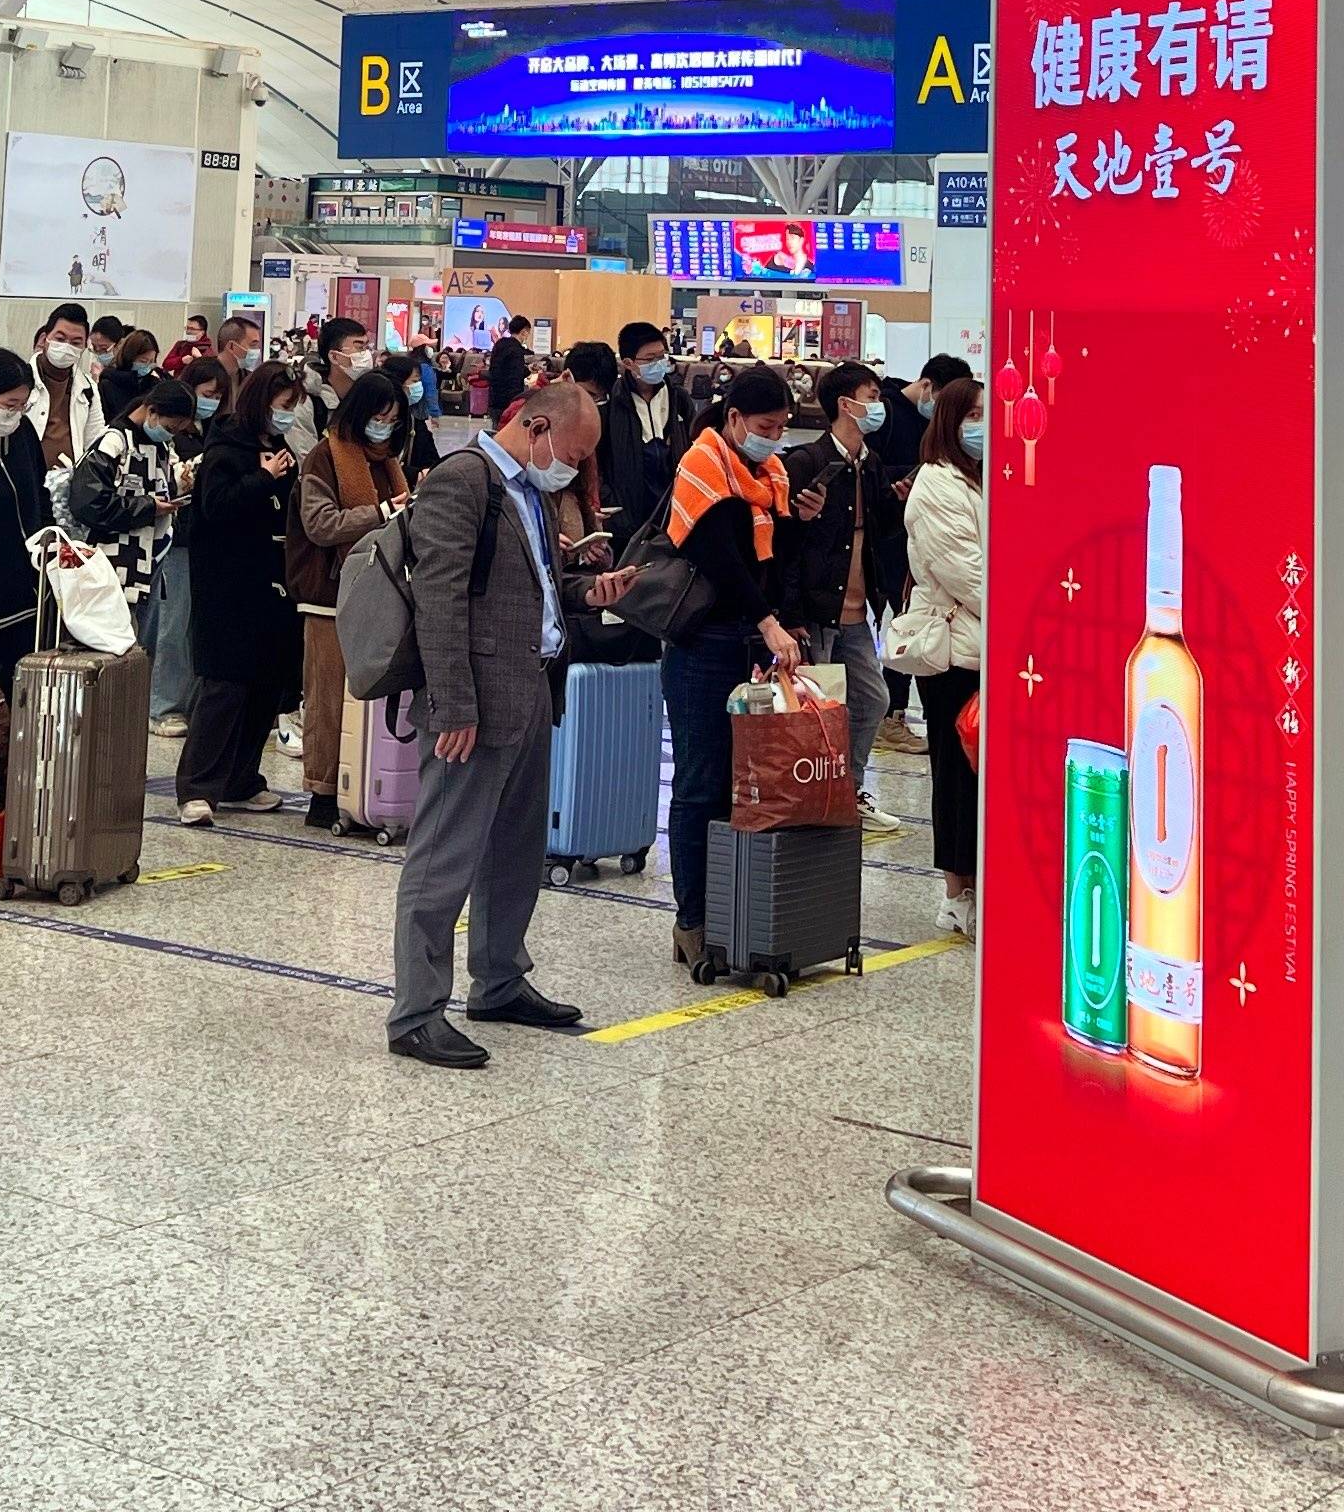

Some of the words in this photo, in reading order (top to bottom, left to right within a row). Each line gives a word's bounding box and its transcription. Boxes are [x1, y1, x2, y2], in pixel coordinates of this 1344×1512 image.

[361, 55, 390, 116] B
[399, 61, 423, 98] 区
[917, 35, 965, 104] A
[396, 100, 423, 115] Area
[1050, 119, 1242, 200] 天地壹号
[1285, 829, 1297, 898] SPRING
